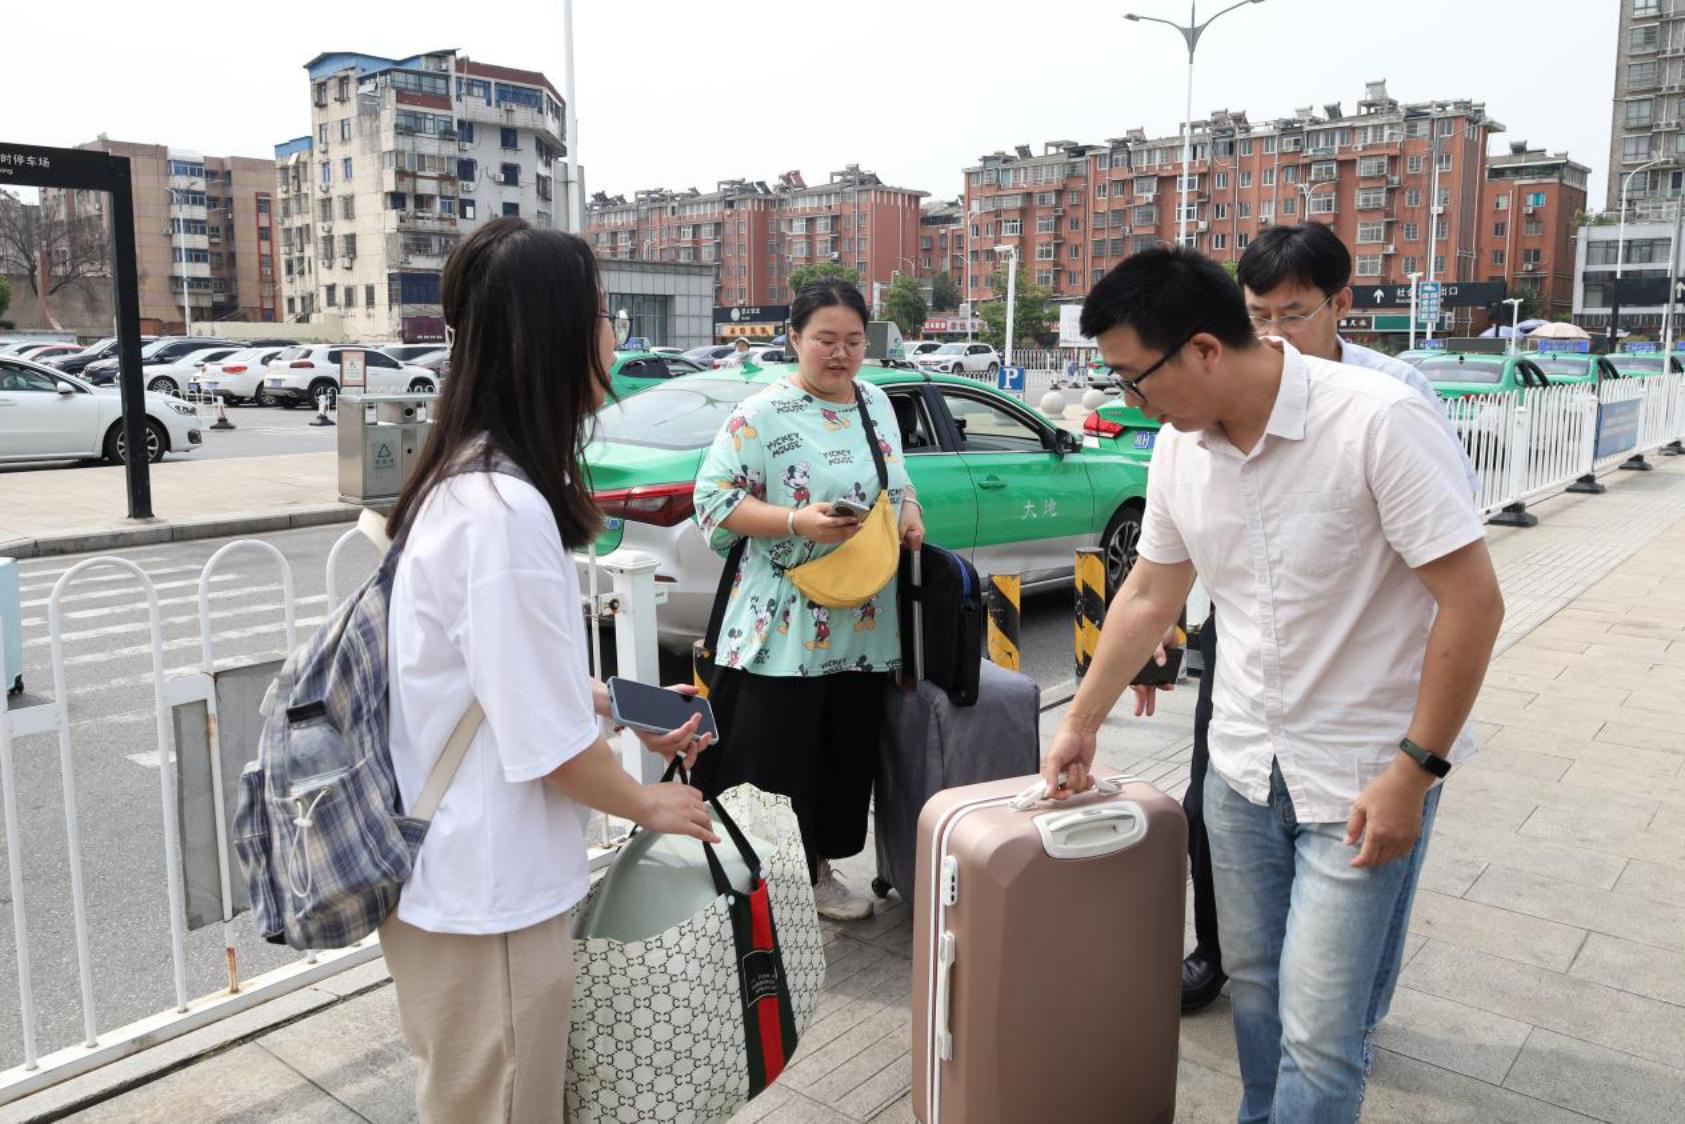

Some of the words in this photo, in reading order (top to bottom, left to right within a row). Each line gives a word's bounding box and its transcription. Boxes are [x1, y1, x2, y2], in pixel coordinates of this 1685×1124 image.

[1003, 367, 1019, 389] P
[767, 432, 801, 451] MICKEY
[772, 441, 801, 459] MOUSE
[822, 449, 851, 459] MICKEY
